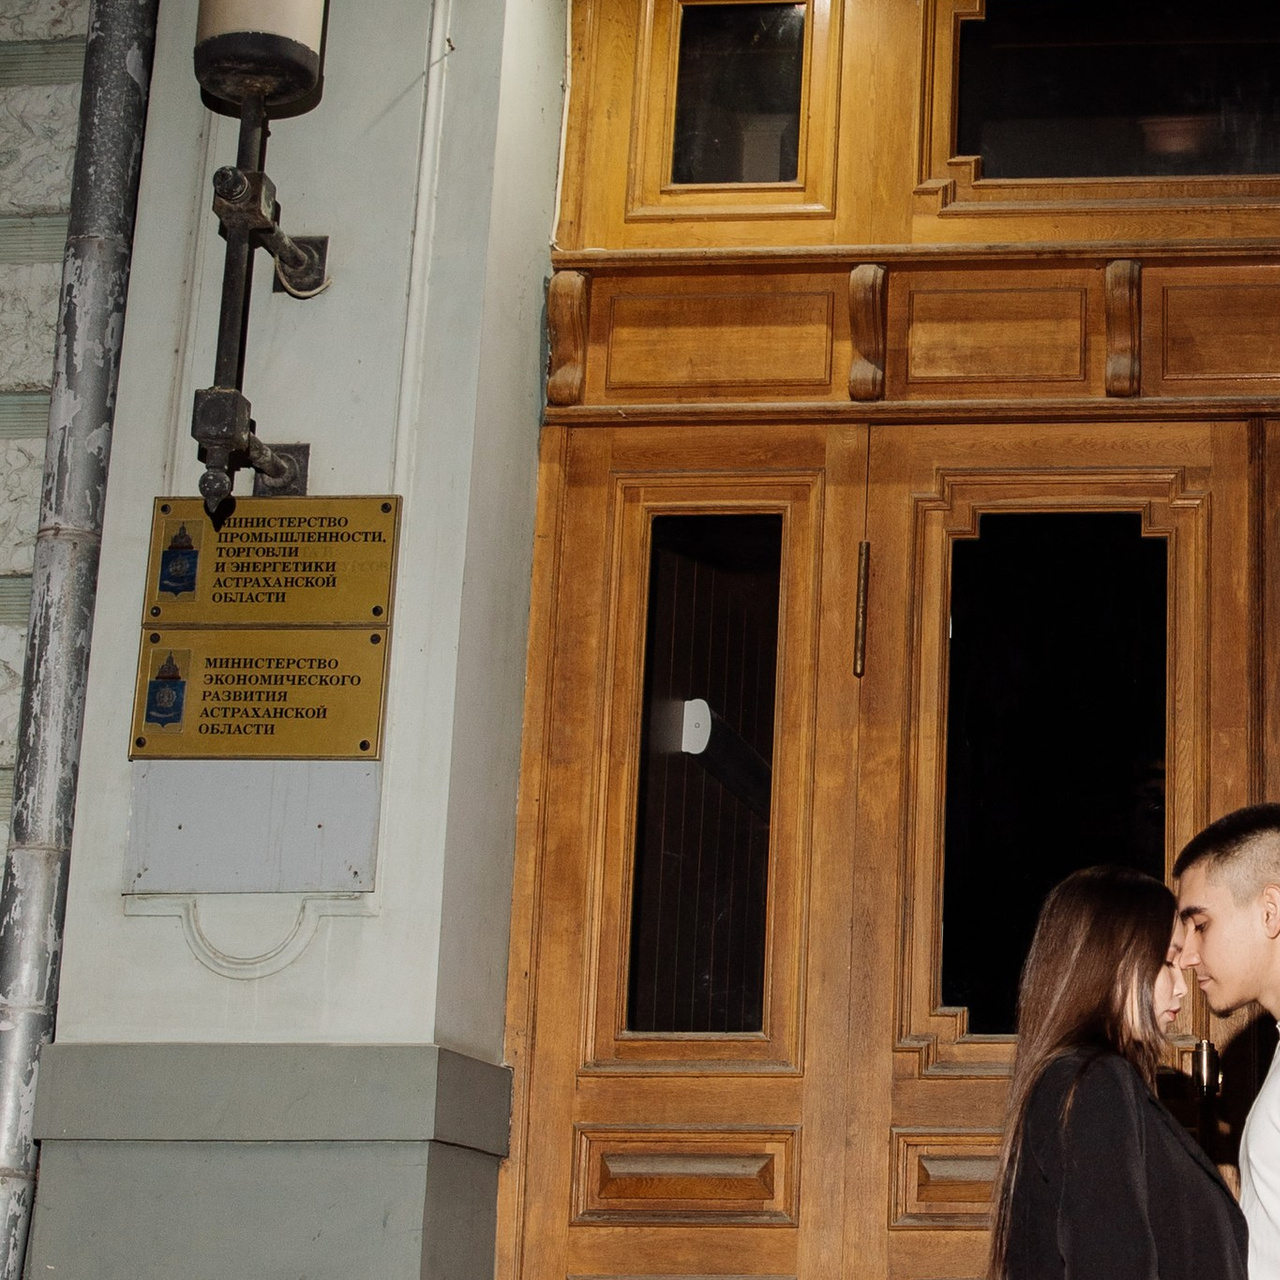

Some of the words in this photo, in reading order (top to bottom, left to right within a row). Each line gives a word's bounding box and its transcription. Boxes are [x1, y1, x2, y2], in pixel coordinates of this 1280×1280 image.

[221, 517, 348, 528] МИНИСТЕРСТВО
[217, 531, 386, 544] ПРОМЫШЛЕННОСТИ,
[216, 547, 299, 558] ТОРГОВЛИ
[215, 561, 226, 572] И
[230, 561, 336, 572] ЭНЕРГЕТИКИ
[213, 574, 337, 588] АСТРАХАНСКОЙ
[212, 592, 286, 603] ОБЛАСТИ
[204, 658, 338, 669] МИНИСТЕРСТВО
[203, 674, 361, 686] ЭКОНОМИЧЕСКОГО
[202, 690, 288, 702] РАЗВИТИЯ
[200, 705, 327, 719] АСТРАХАНСКОЙ
[198, 724, 275, 735] ОБЛАСТИ
